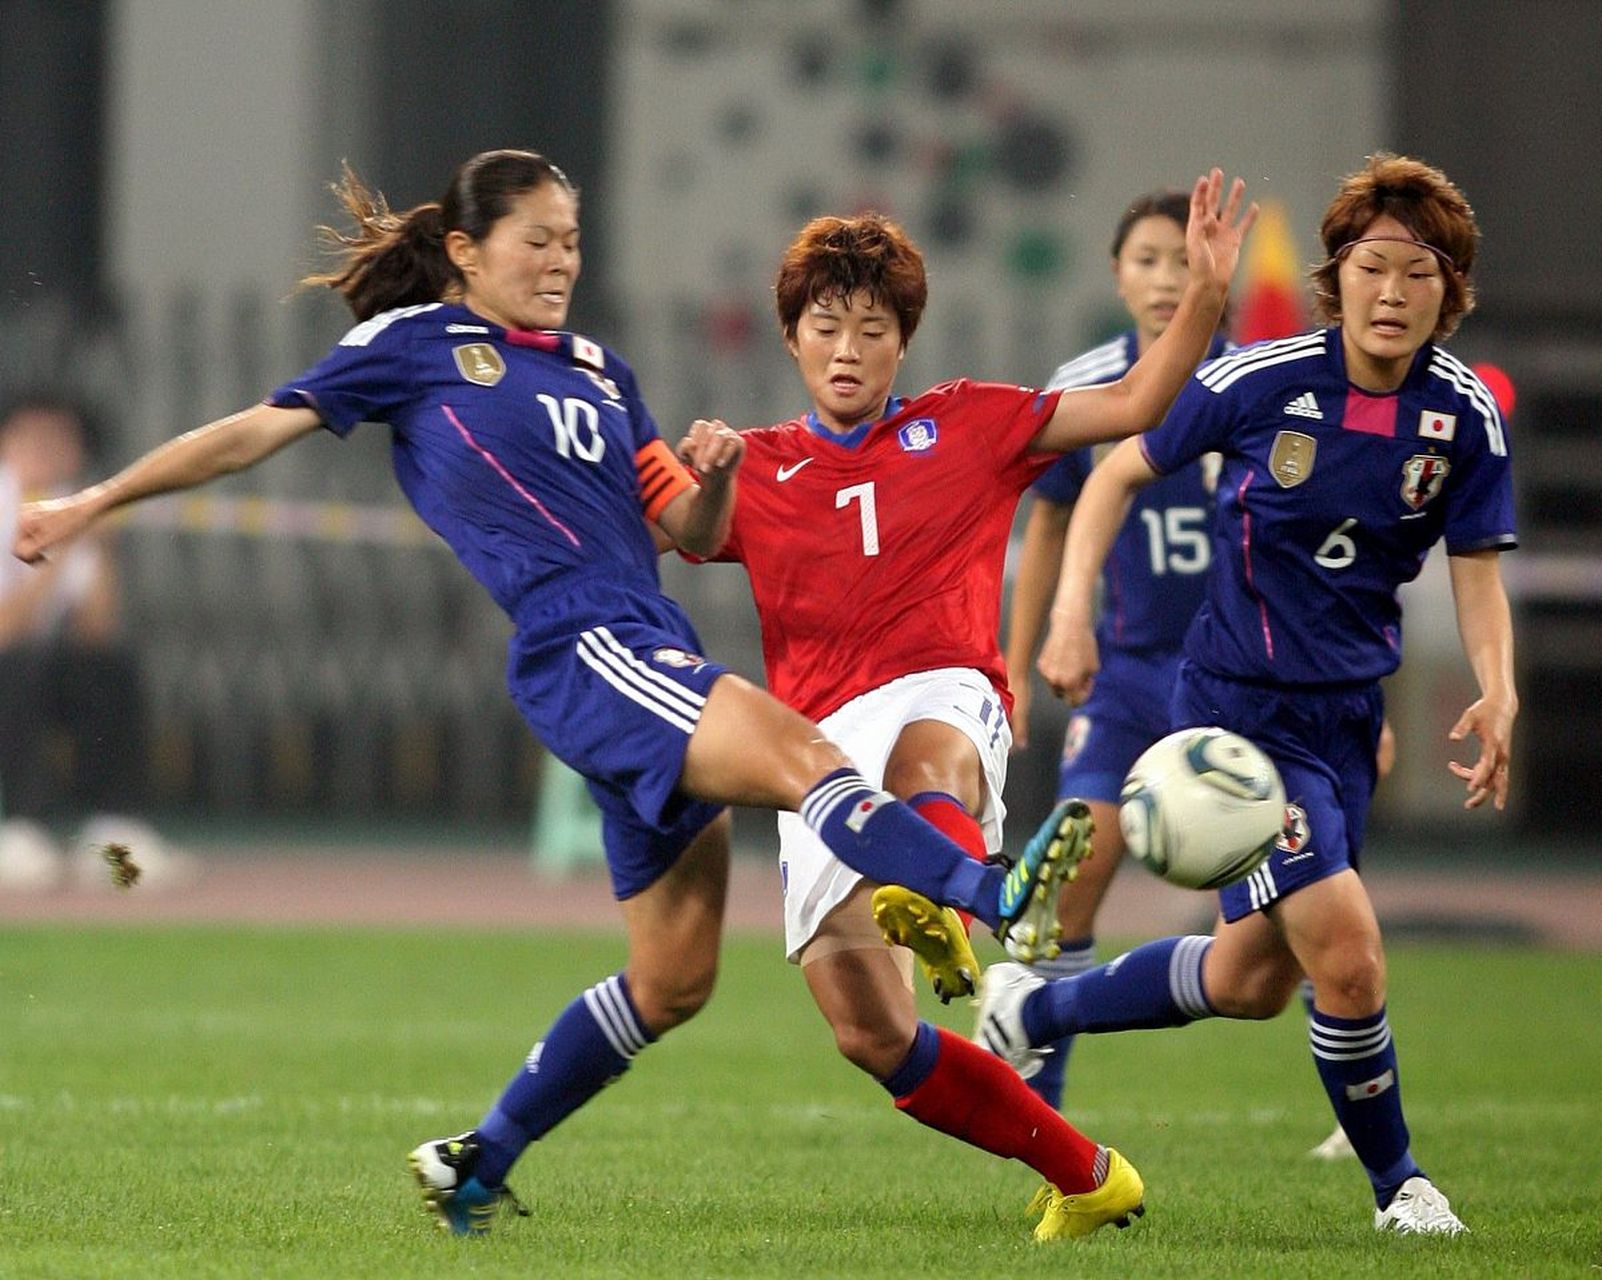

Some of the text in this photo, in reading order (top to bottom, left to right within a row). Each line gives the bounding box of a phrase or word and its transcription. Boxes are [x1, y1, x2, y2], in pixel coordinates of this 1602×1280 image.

[535, 393, 606, 463] 10
[834, 480, 880, 557] 7
[1141, 507, 1211, 575] 15
[1313, 518, 1359, 569] 6
